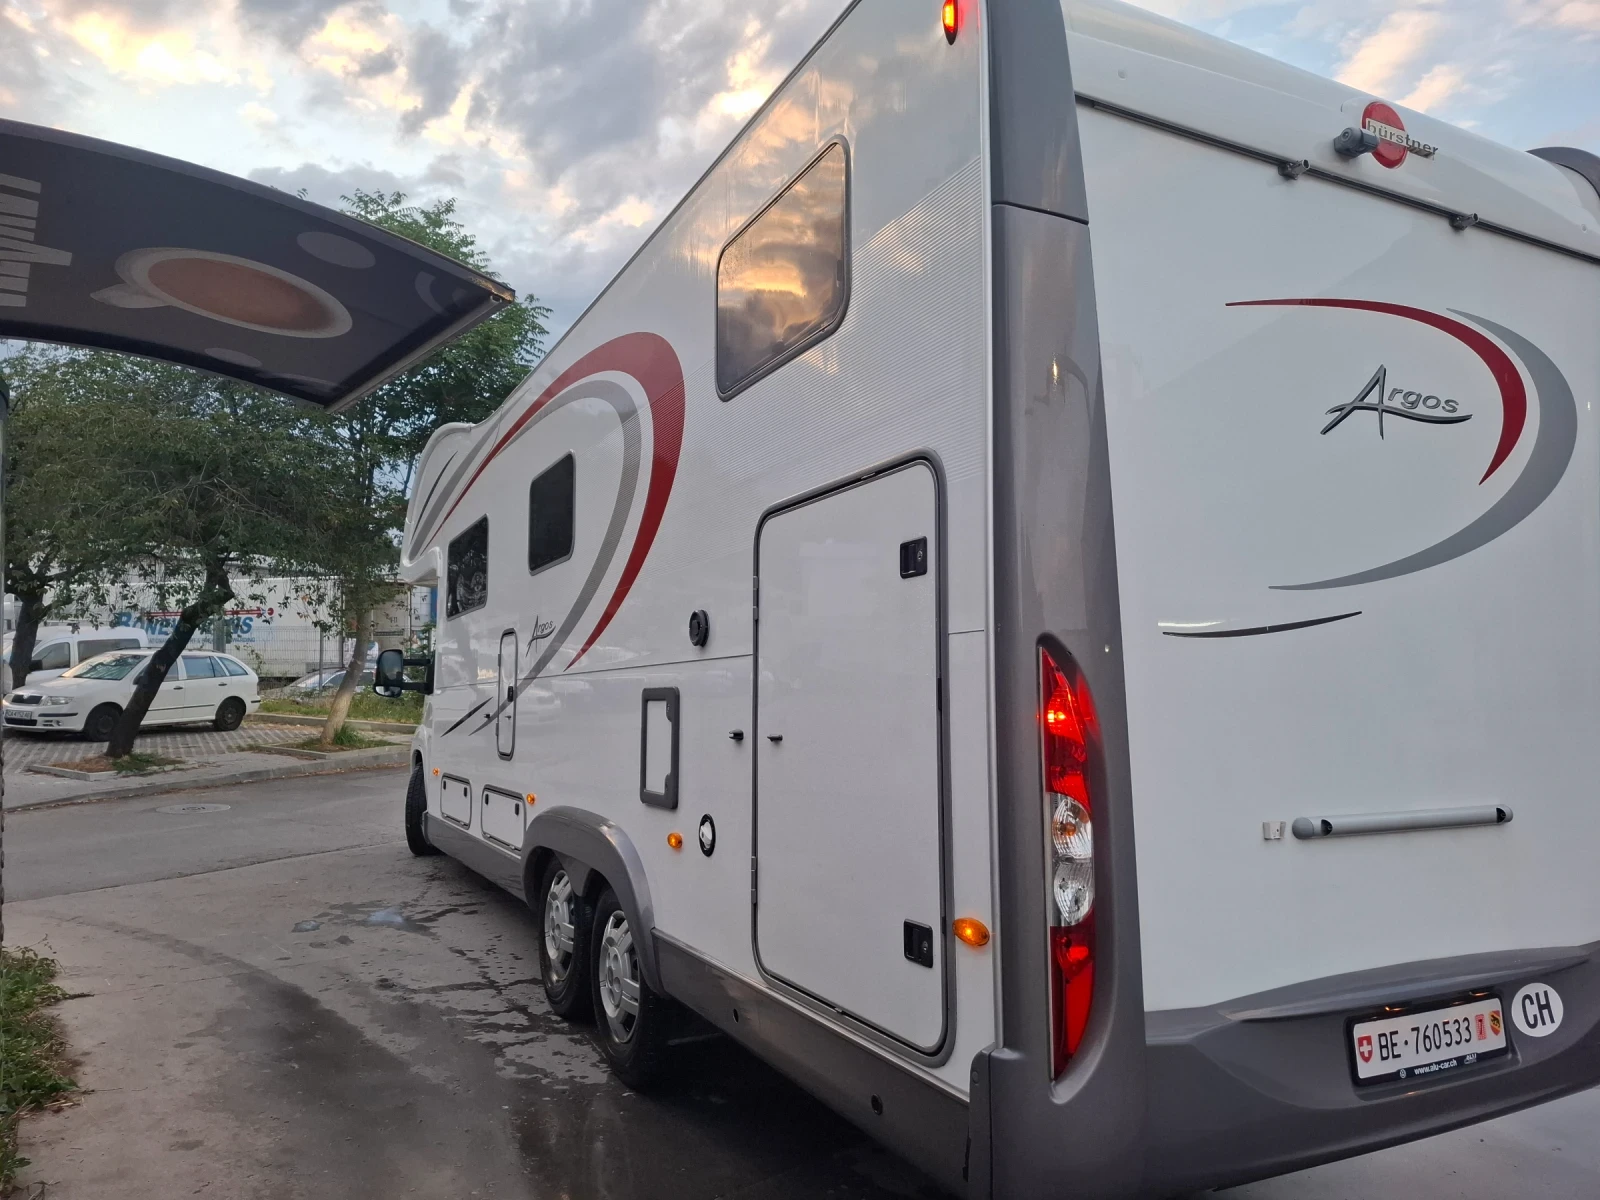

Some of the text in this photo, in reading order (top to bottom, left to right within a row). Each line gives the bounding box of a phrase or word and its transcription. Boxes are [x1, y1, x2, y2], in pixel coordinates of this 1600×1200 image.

[1367, 120, 1439, 155] bürstner
[1320, 364, 1473, 440] Argos
[525, 614, 556, 658] Argos
[1521, 990, 1555, 1029] CH
[1414, 1059, 1458, 1075] www.alu-car.ch
